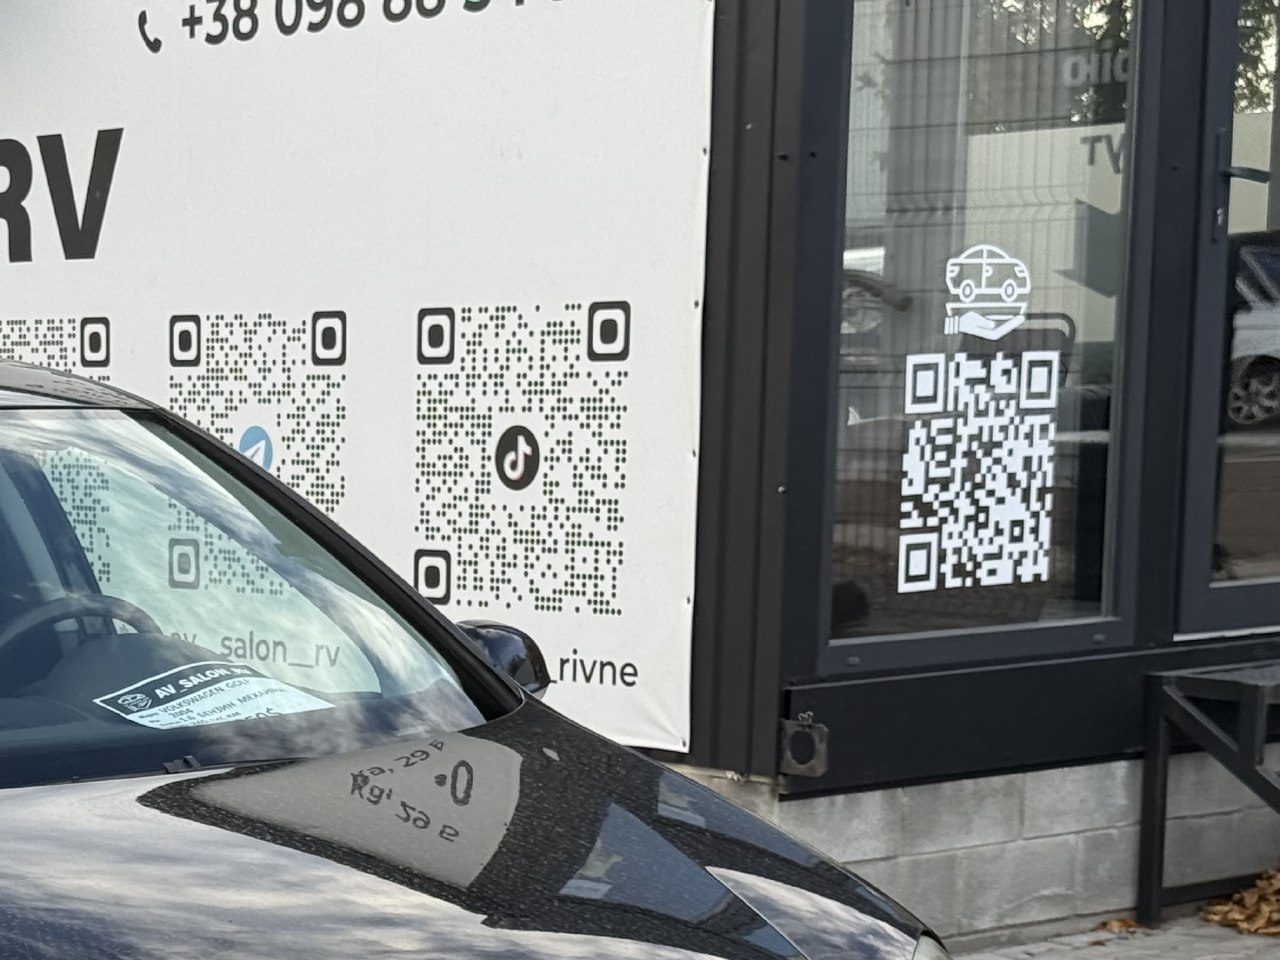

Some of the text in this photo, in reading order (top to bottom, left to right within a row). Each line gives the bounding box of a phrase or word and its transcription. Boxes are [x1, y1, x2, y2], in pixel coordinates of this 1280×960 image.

[182, 0, 259, 45] +38
[275, 0, 366, 36] 098
[158, 684, 225, 714] VOLKSWAGEN
